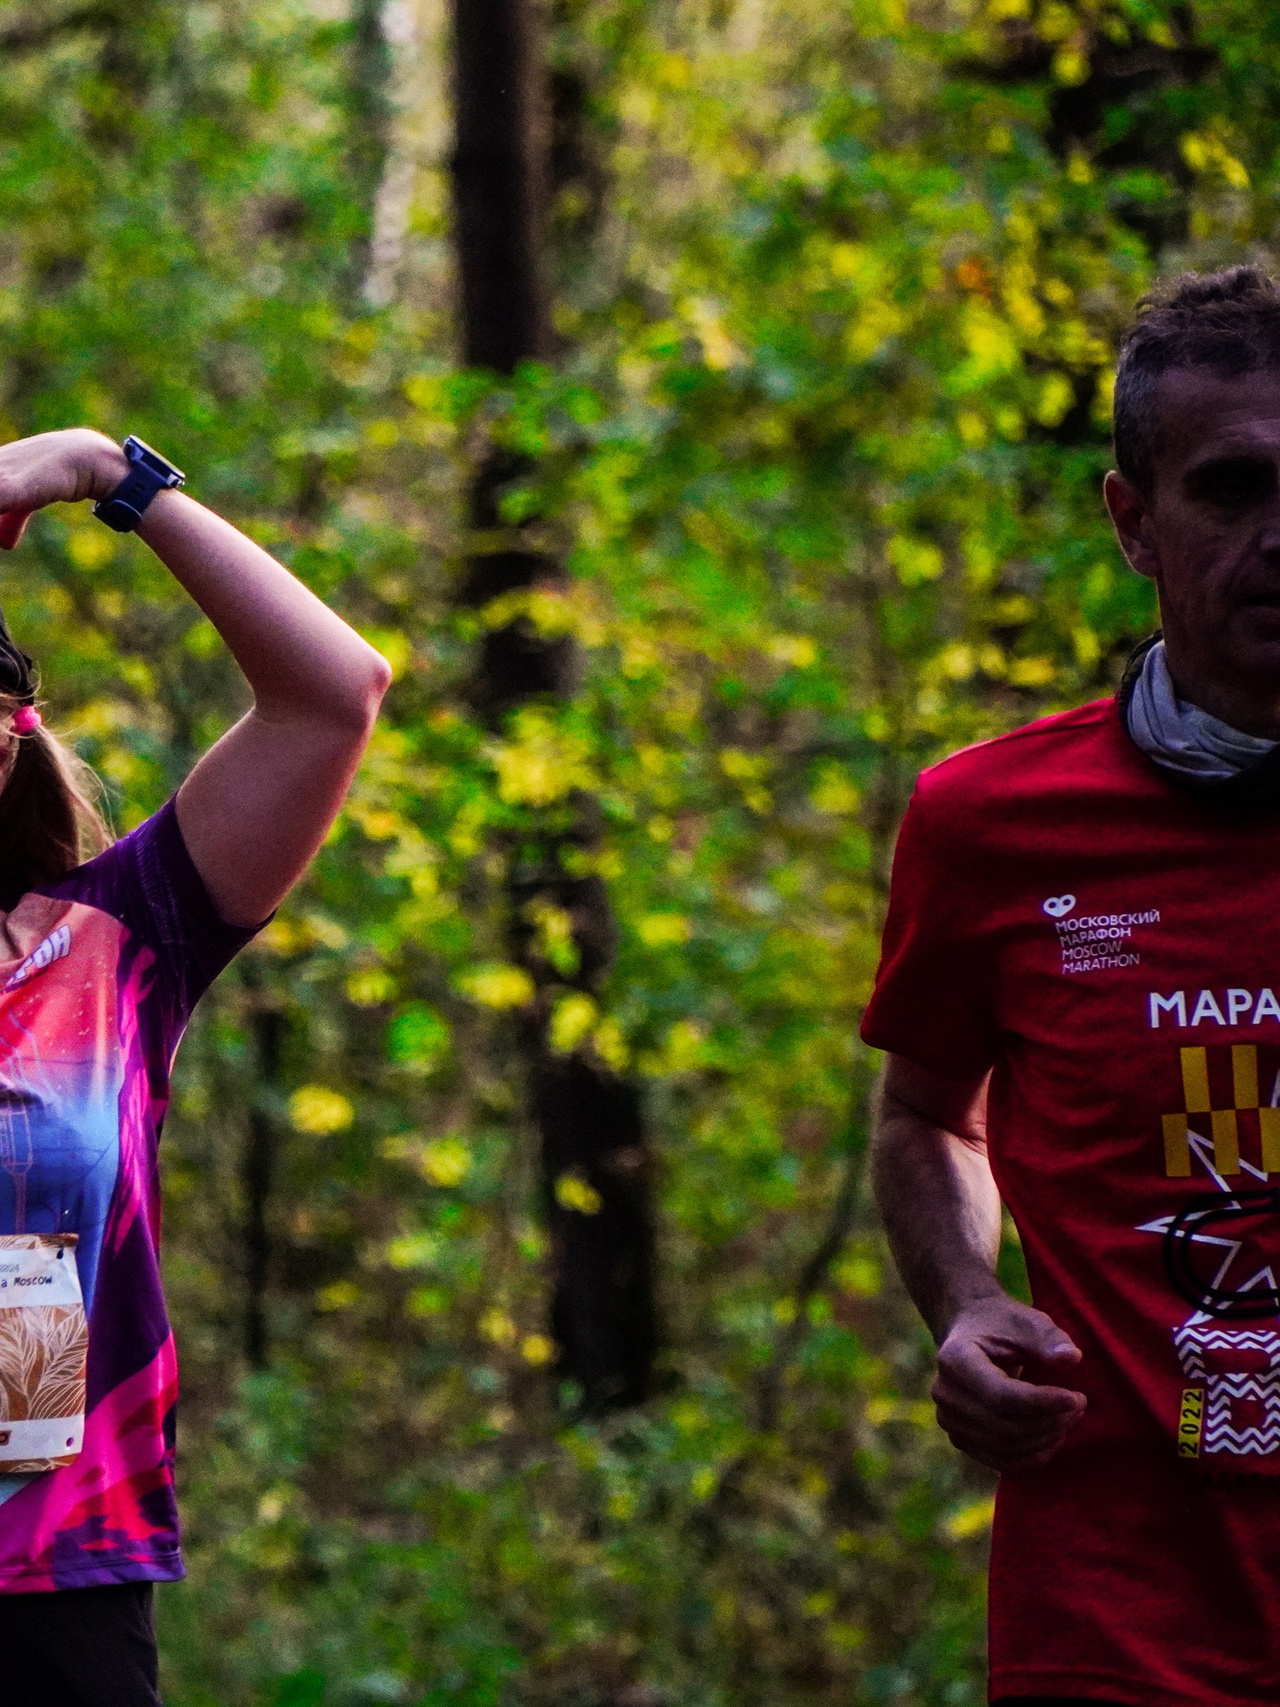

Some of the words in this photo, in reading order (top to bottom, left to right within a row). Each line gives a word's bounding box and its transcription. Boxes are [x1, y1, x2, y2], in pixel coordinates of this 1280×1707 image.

[1054, 909, 1160, 933] МОСКОВСКИЙ
[1060, 927, 1131, 947] МАРАФОН
[1062, 940, 1122, 961] MOSCOW
[1062, 953, 1140, 974] MARATHON
[13, 1276, 53, 1286] Moscow
[1180, 1389, 1203, 1456] 2022
